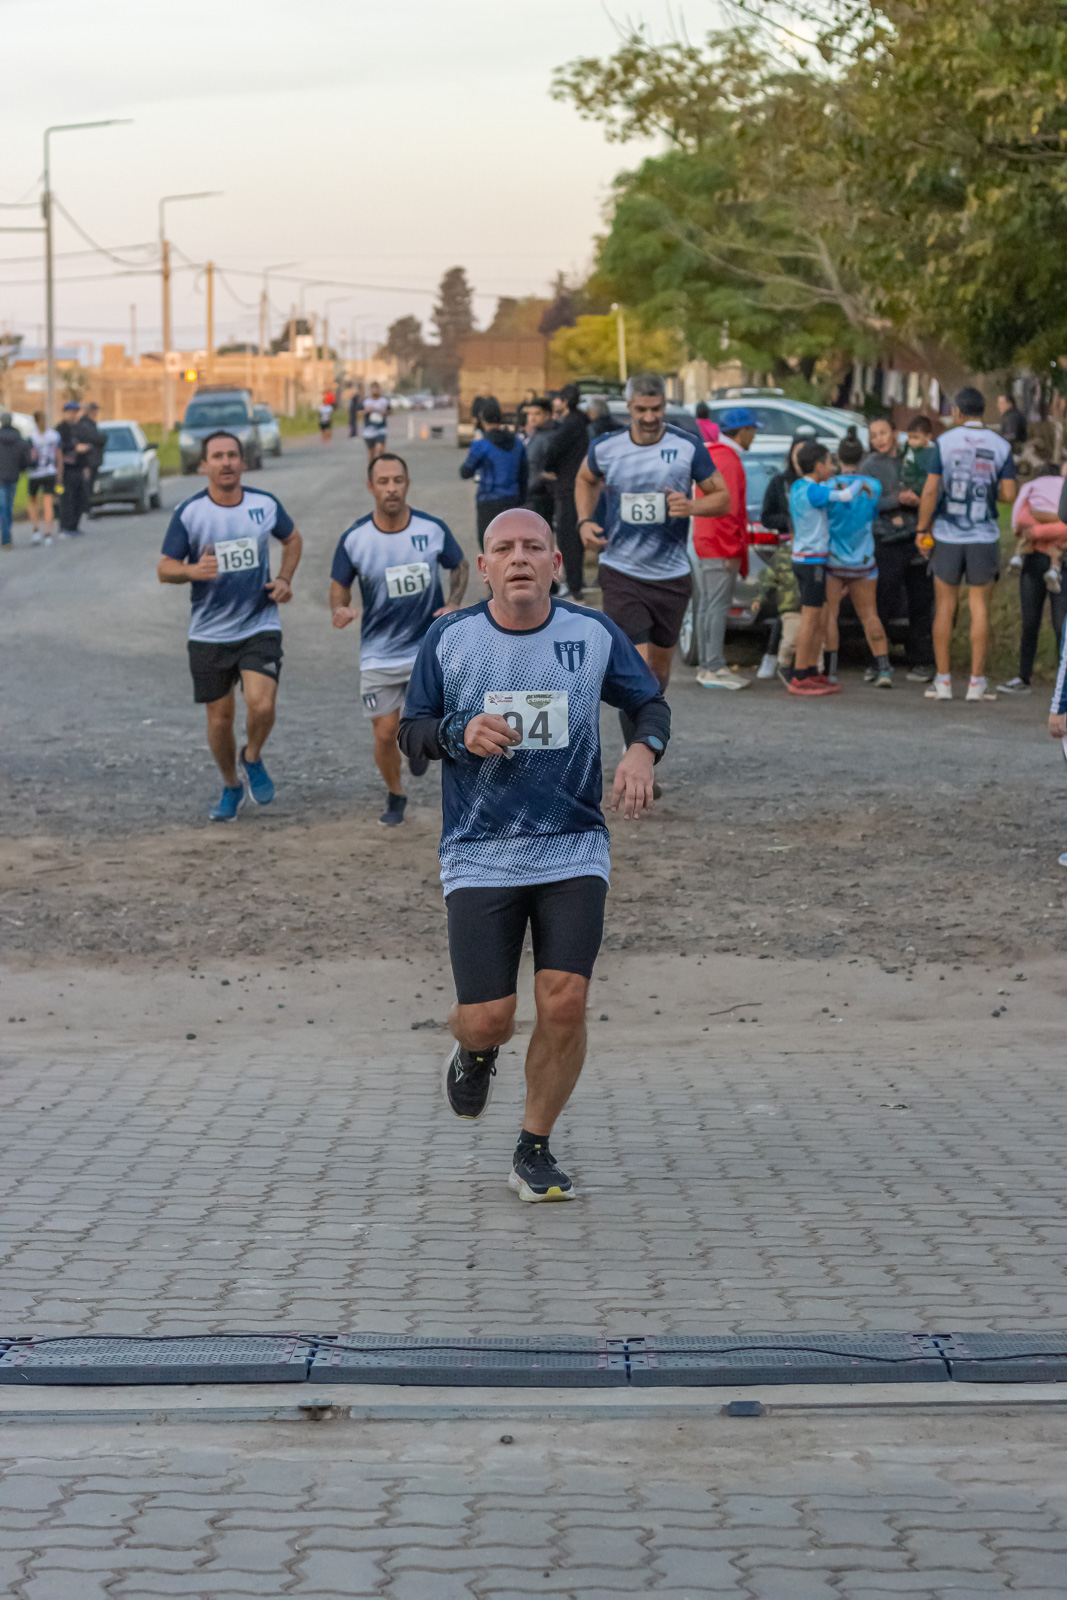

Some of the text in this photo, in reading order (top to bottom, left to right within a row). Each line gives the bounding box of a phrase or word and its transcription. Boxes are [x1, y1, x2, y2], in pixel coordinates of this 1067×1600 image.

[631, 504, 656, 521] 63
[220, 548, 254, 570] 159
[394, 573, 425, 595] 161
[559, 643, 580, 651] SFC
[503, 711, 553, 747] 94
